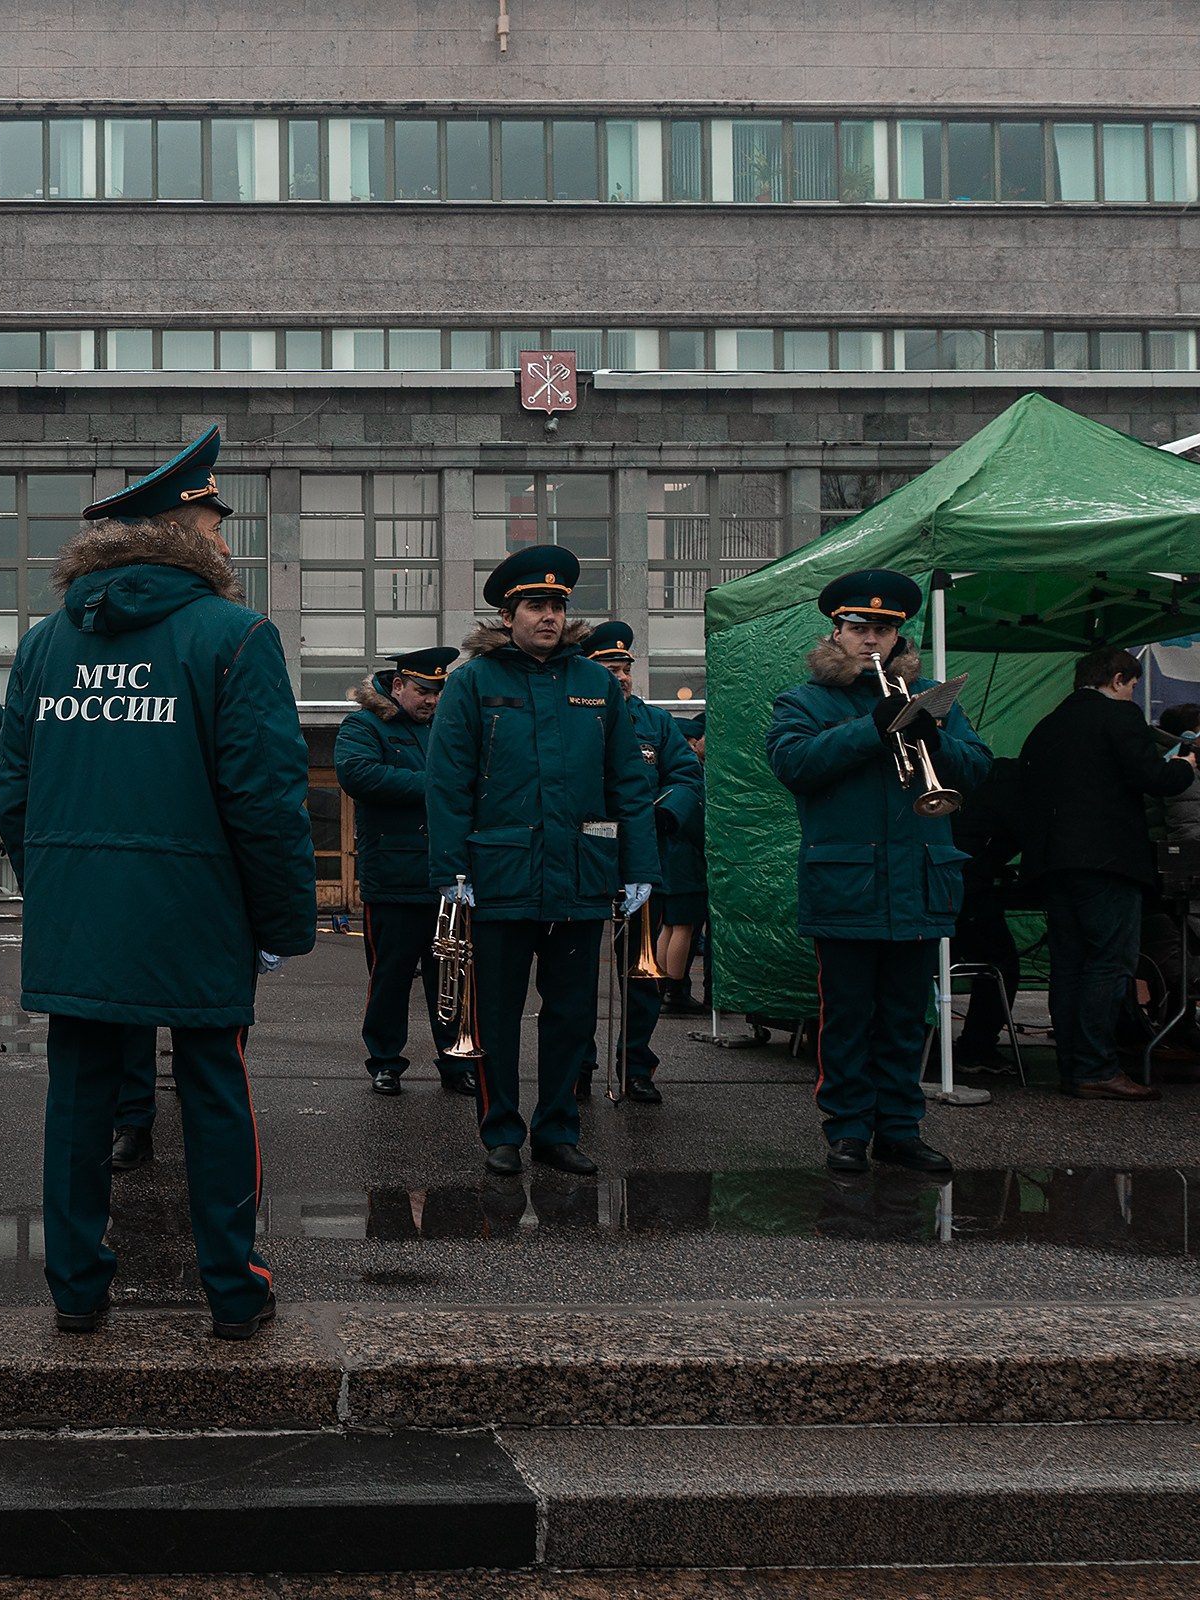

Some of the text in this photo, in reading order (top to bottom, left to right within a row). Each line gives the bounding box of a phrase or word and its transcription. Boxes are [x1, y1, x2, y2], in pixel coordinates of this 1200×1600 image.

[73, 663, 152, 690] МЧС
[36, 695, 178, 724] РОССИИ
[582, 698, 606, 706] РОССИИ
